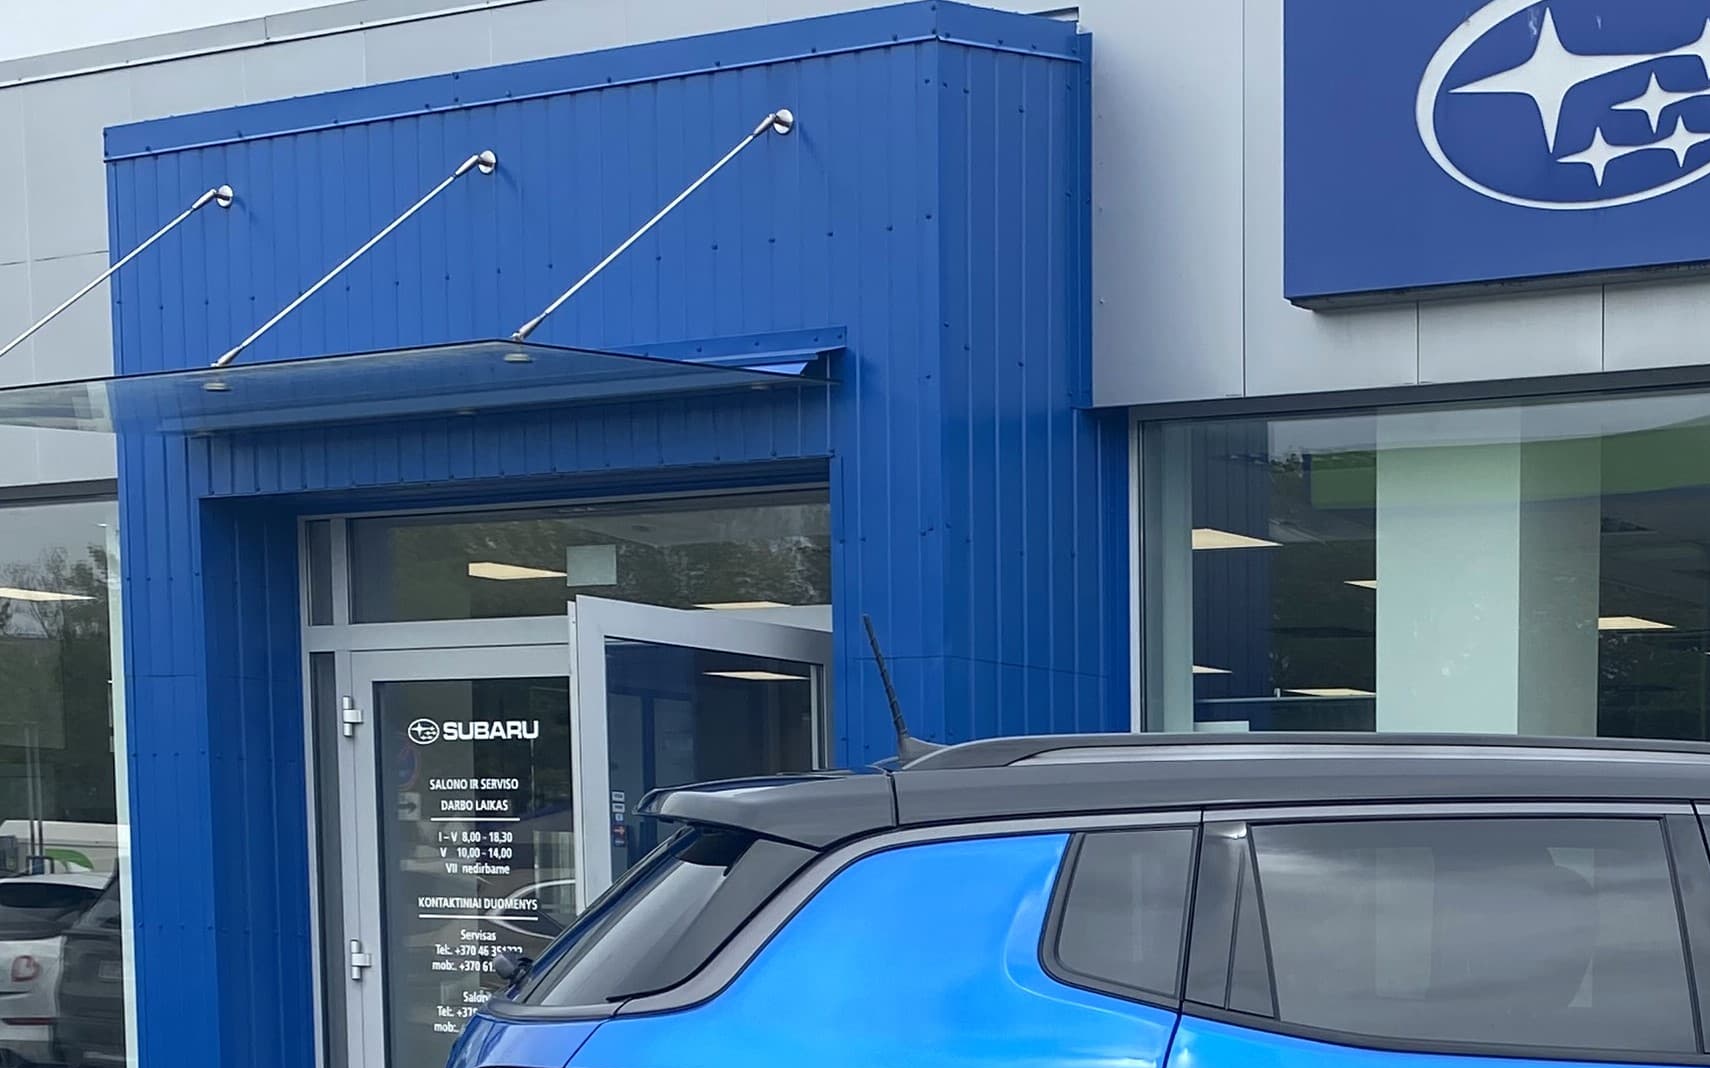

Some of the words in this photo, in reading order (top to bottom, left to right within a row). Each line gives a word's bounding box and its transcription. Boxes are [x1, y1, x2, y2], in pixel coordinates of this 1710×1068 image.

[443, 720, 539, 740] SUBARU
[429, 778, 468, 790] SALONO
[469, 778, 479, 790] IR
[480, 778, 519, 790] SERVISO
[441, 799, 473, 811] DARBO
[475, 799, 509, 811] LAIKAS
[418, 897, 482, 908] KONTAKTINIAI
[484, 898, 538, 910] DUOMENYS
[460, 929, 496, 941] Servisas
[455, 945, 476, 956] +370
[478, 945, 489, 956] 46
[459, 960, 480, 972] +370
